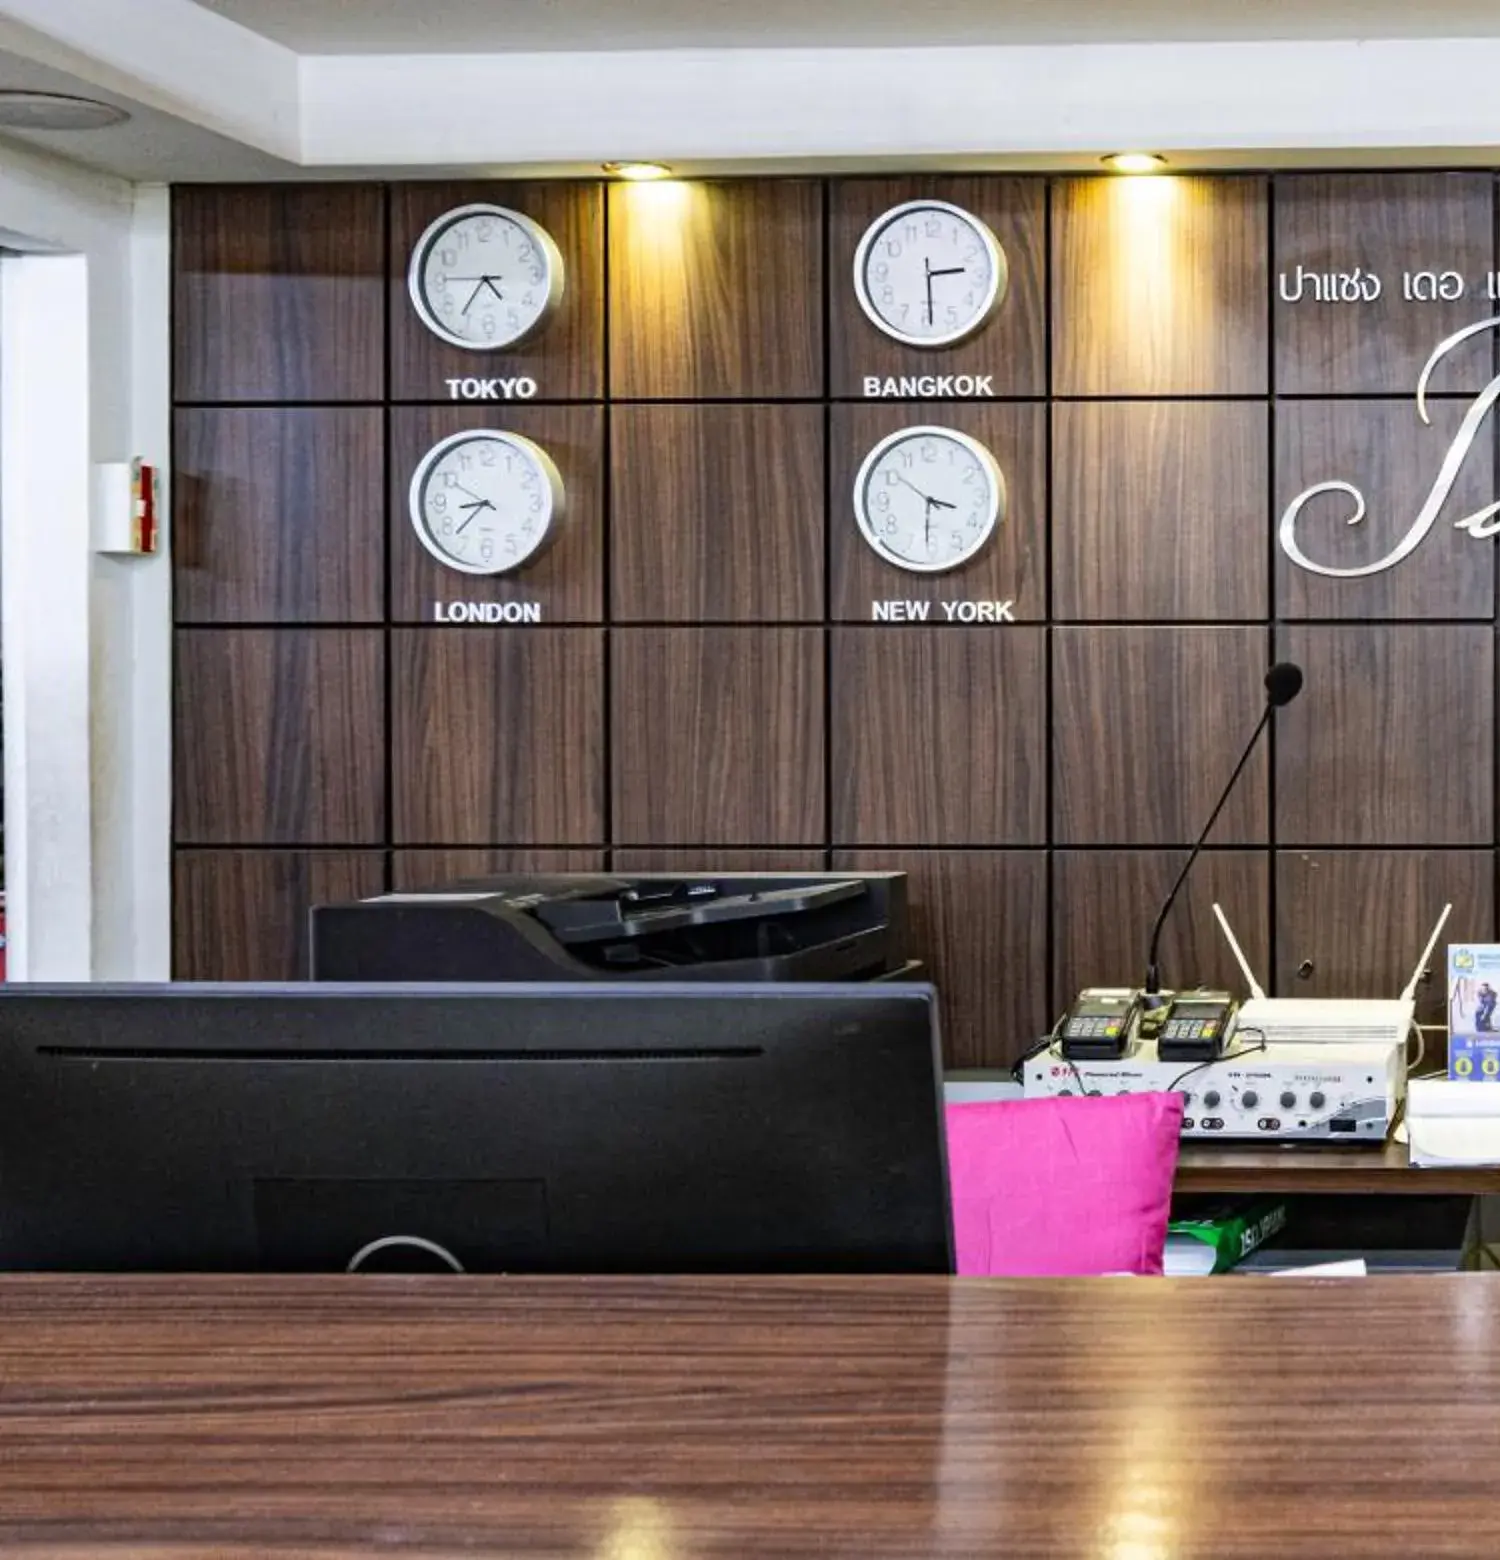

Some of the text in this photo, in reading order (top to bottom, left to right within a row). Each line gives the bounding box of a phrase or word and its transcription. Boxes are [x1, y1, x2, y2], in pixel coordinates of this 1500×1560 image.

[1280, 265, 1382, 301] ปาแชง
[1403, 270, 1465, 301] เดอ
[444, 377, 538, 400] TOKYO
[863, 375, 993, 397] BANGKOK
[434, 601, 541, 622] LONDON
[871, 601, 1015, 622] NEW YORK
